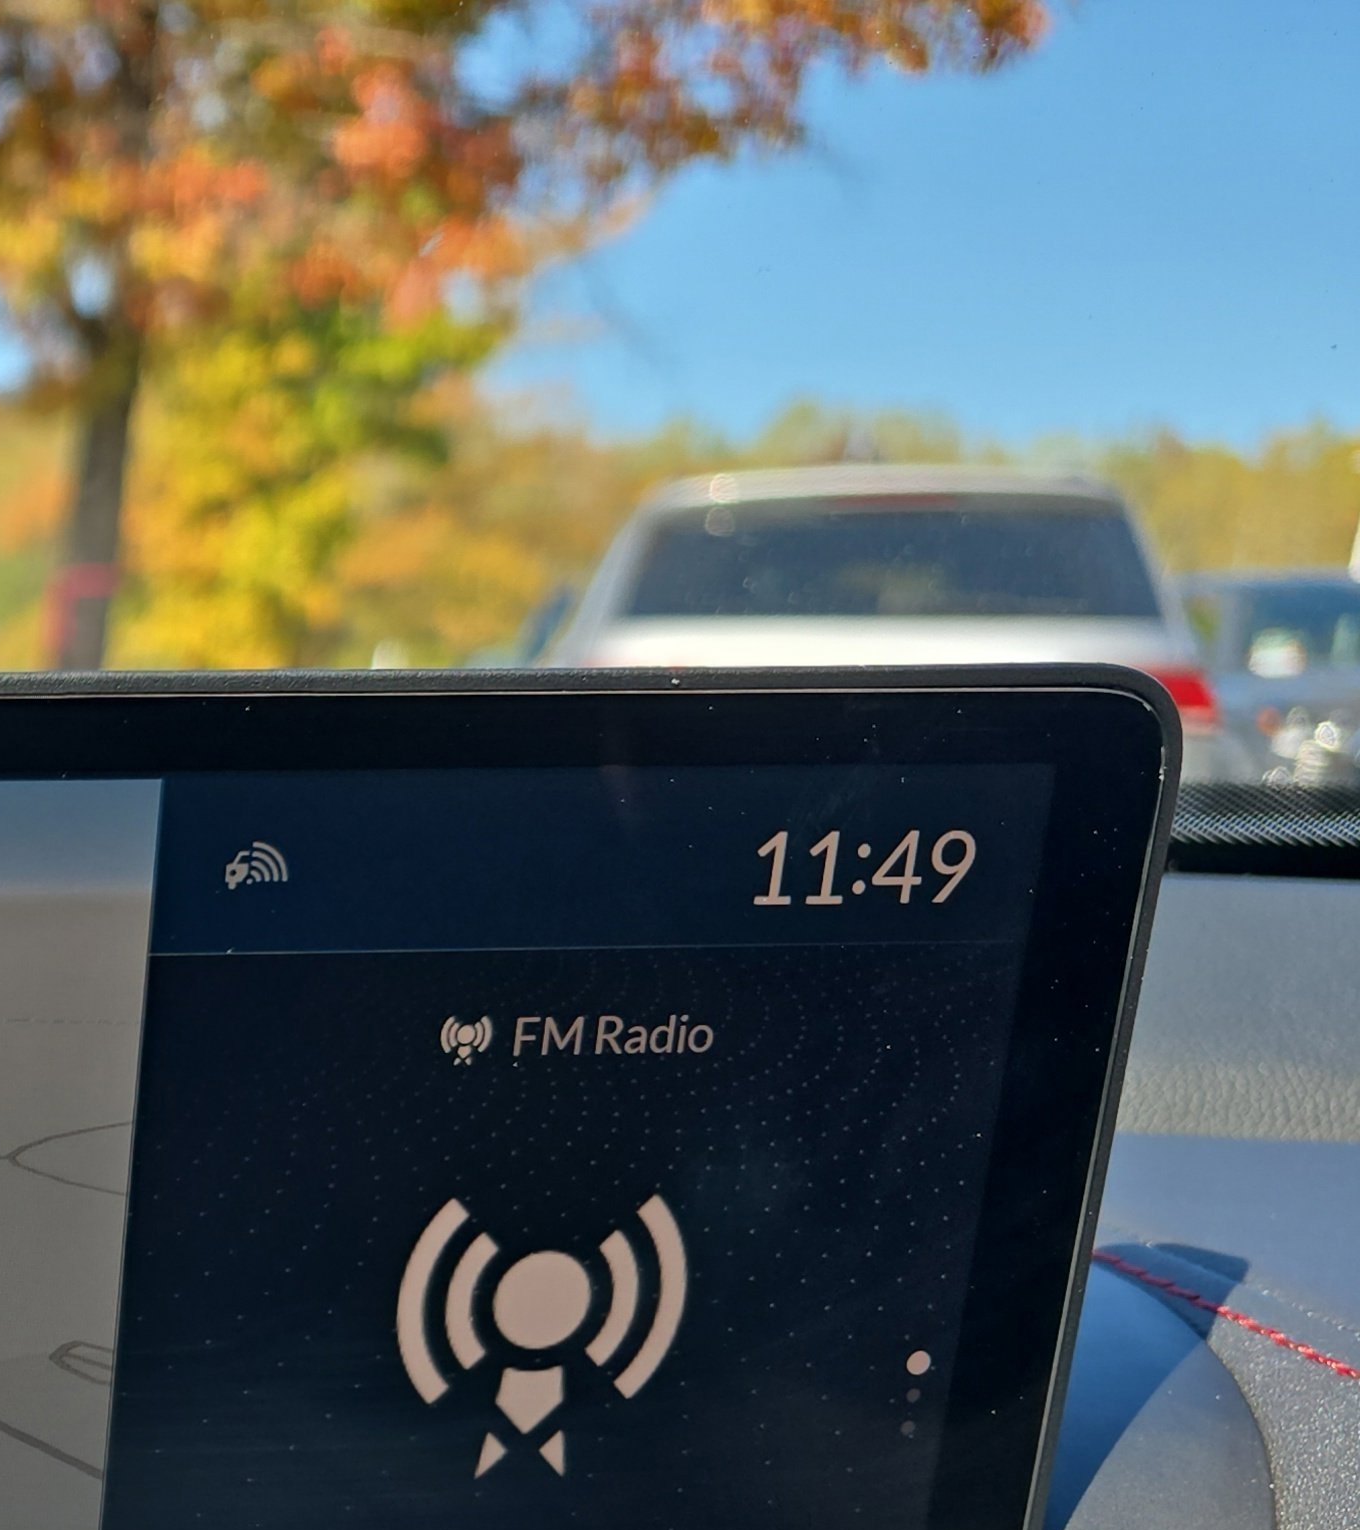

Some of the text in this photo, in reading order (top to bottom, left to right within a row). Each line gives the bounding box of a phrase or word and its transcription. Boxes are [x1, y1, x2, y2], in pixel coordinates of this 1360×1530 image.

[754, 830, 977, 905] 11:49
[512, 1013, 714, 1057] FM Radio
